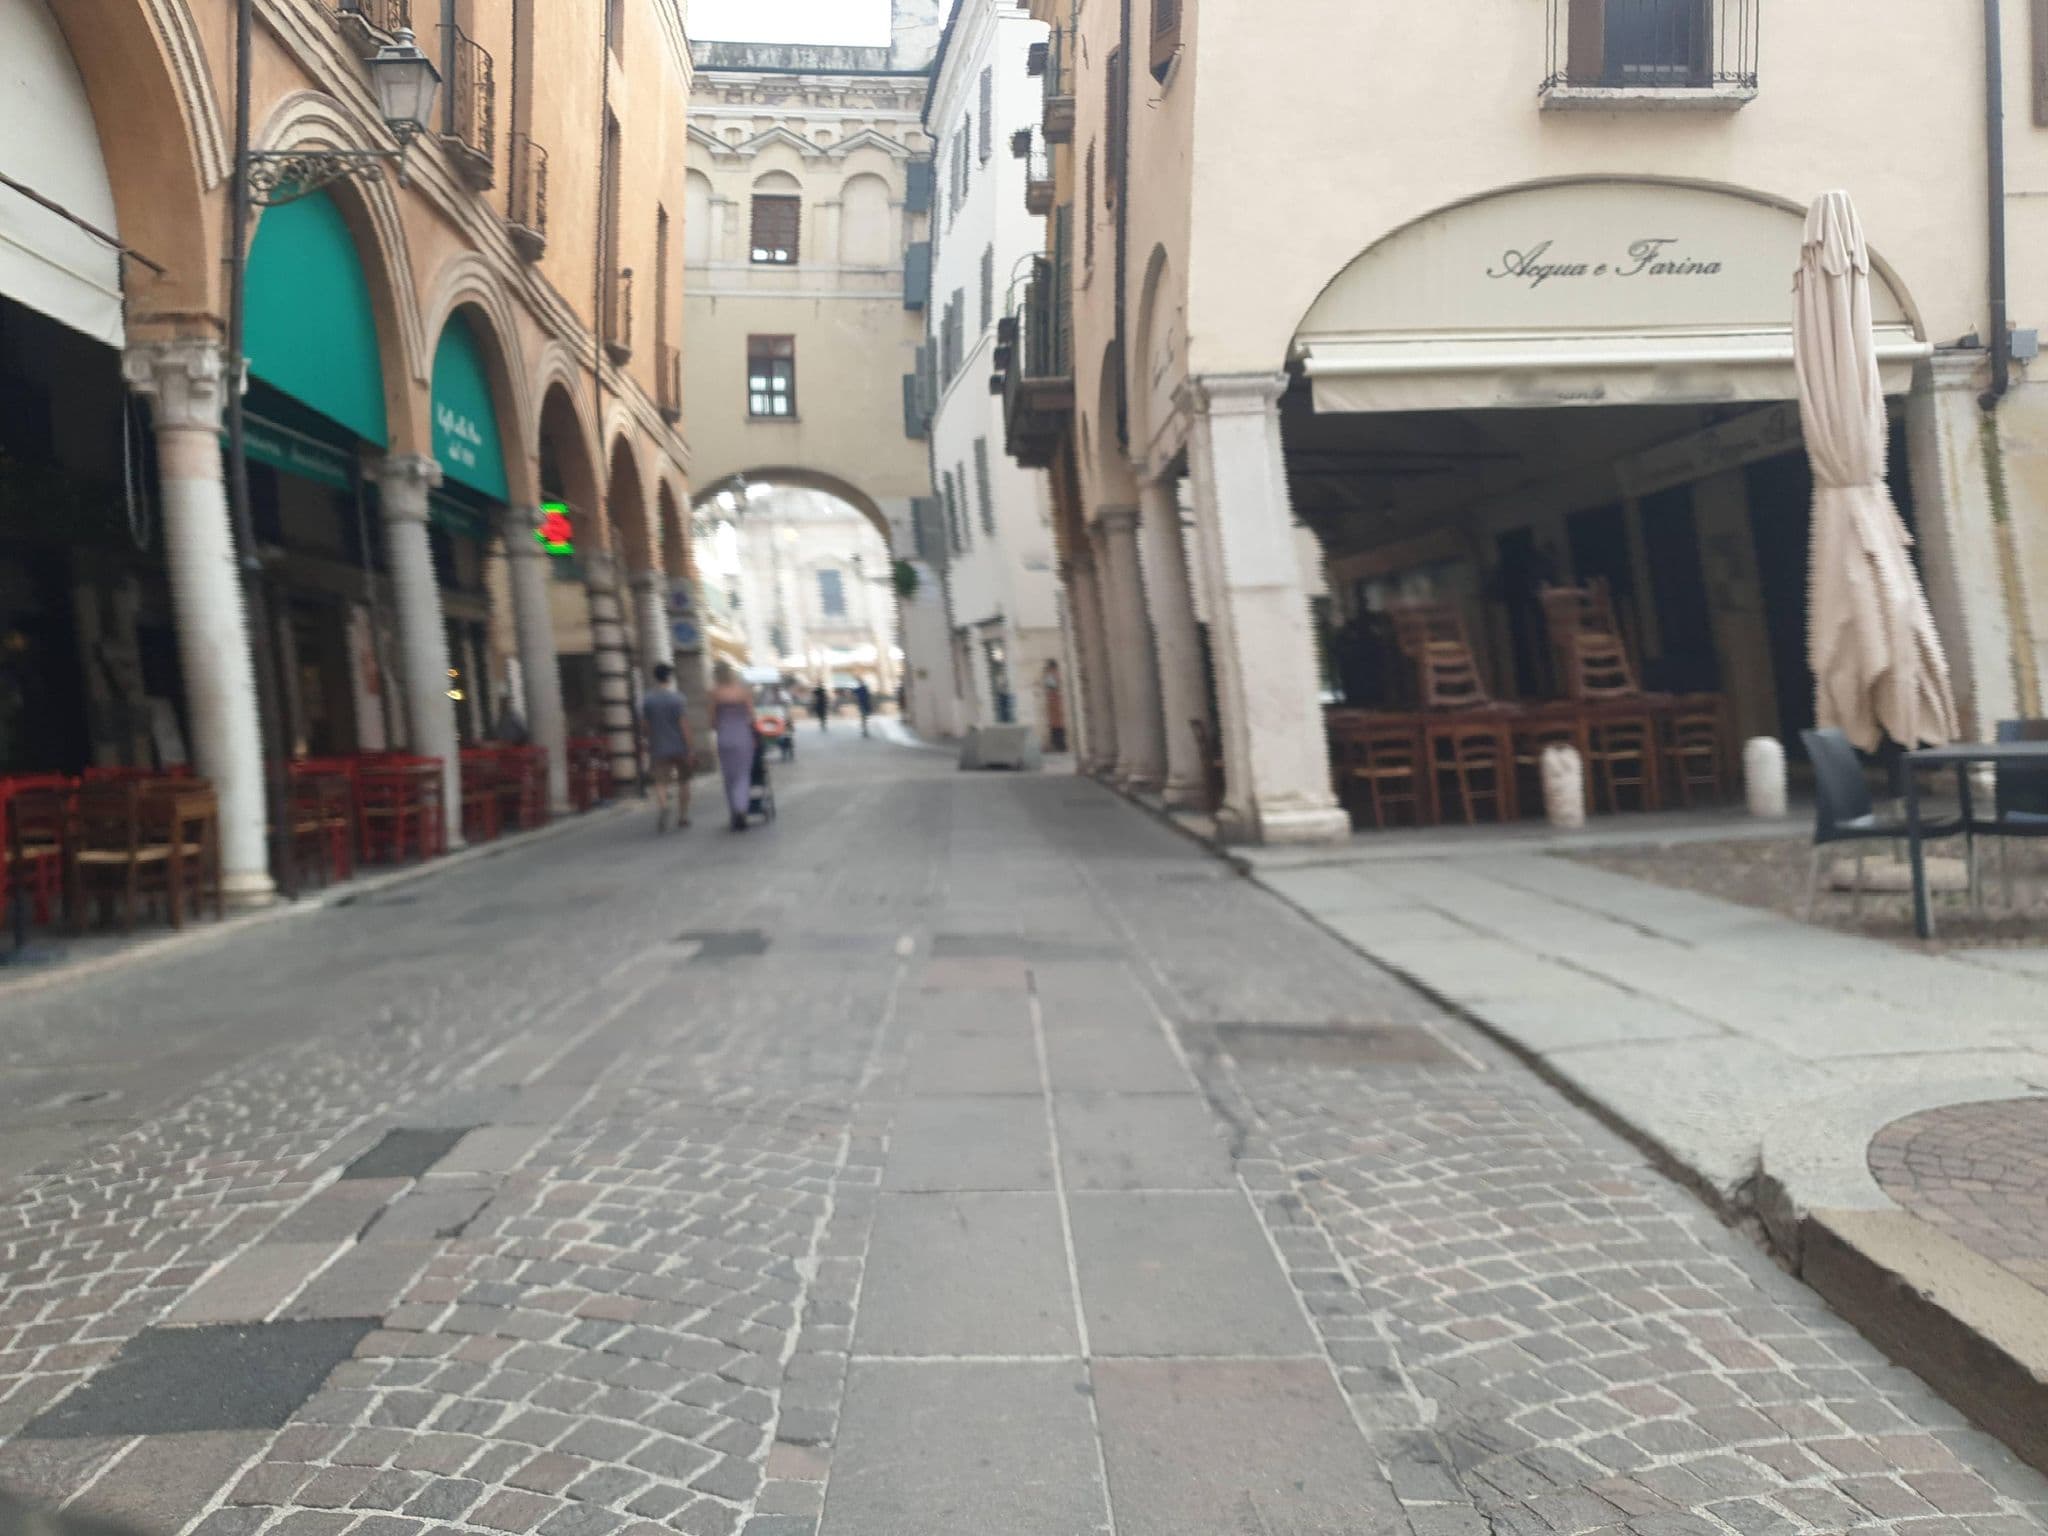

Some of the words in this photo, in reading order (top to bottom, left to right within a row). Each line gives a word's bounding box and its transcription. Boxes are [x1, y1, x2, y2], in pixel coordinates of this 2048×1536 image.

[1486, 240, 1588, 288] Acqua
[1593, 261, 1608, 276] e
[1615, 238, 1722, 276] Farina
